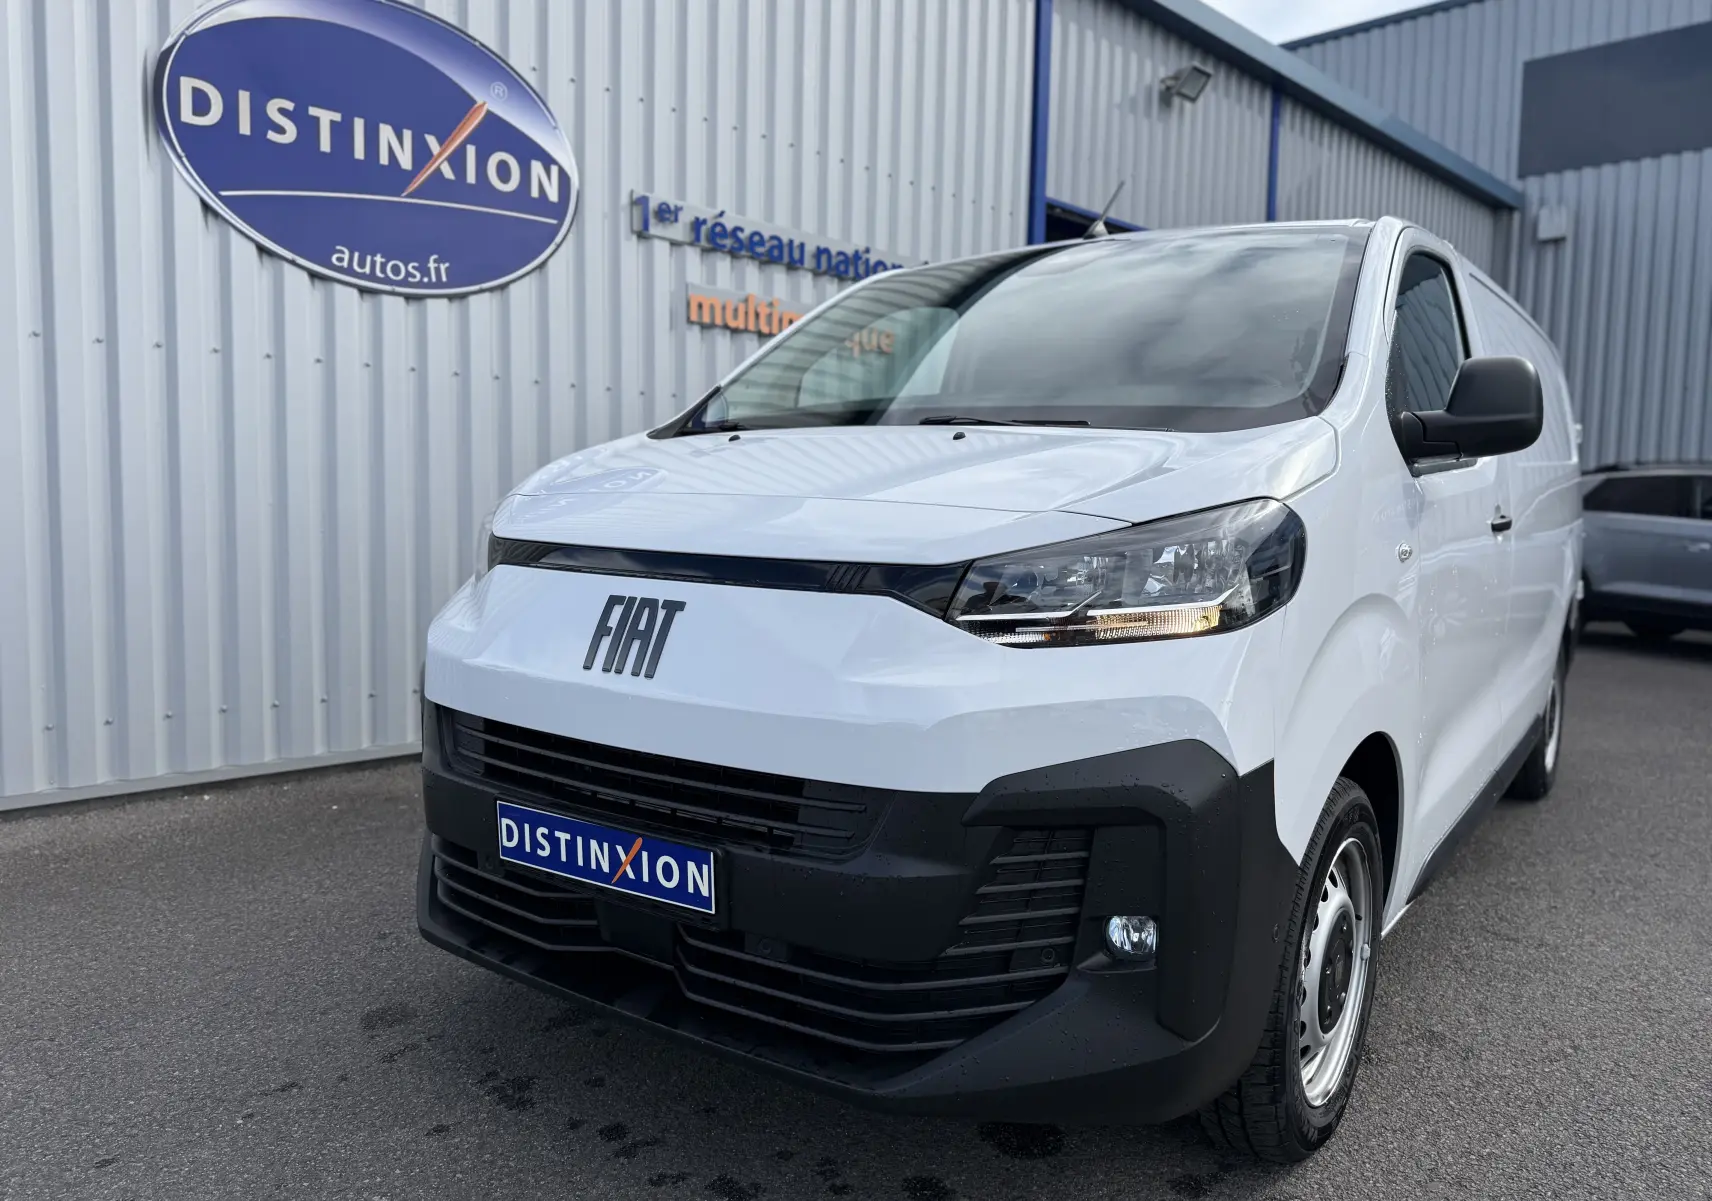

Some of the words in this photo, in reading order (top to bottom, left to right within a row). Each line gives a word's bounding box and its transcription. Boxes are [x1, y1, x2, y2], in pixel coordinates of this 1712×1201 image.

[179, 76, 559, 204] DISTINXION
[331, 246, 450, 283] autos.fr
[634, 195, 684, 231] 1er
[693, 211, 805, 267] réseau
[815, 246, 929, 280] natio
[583, 594, 687, 679] FIAT
[501, 817, 709, 897] DISTINXION
